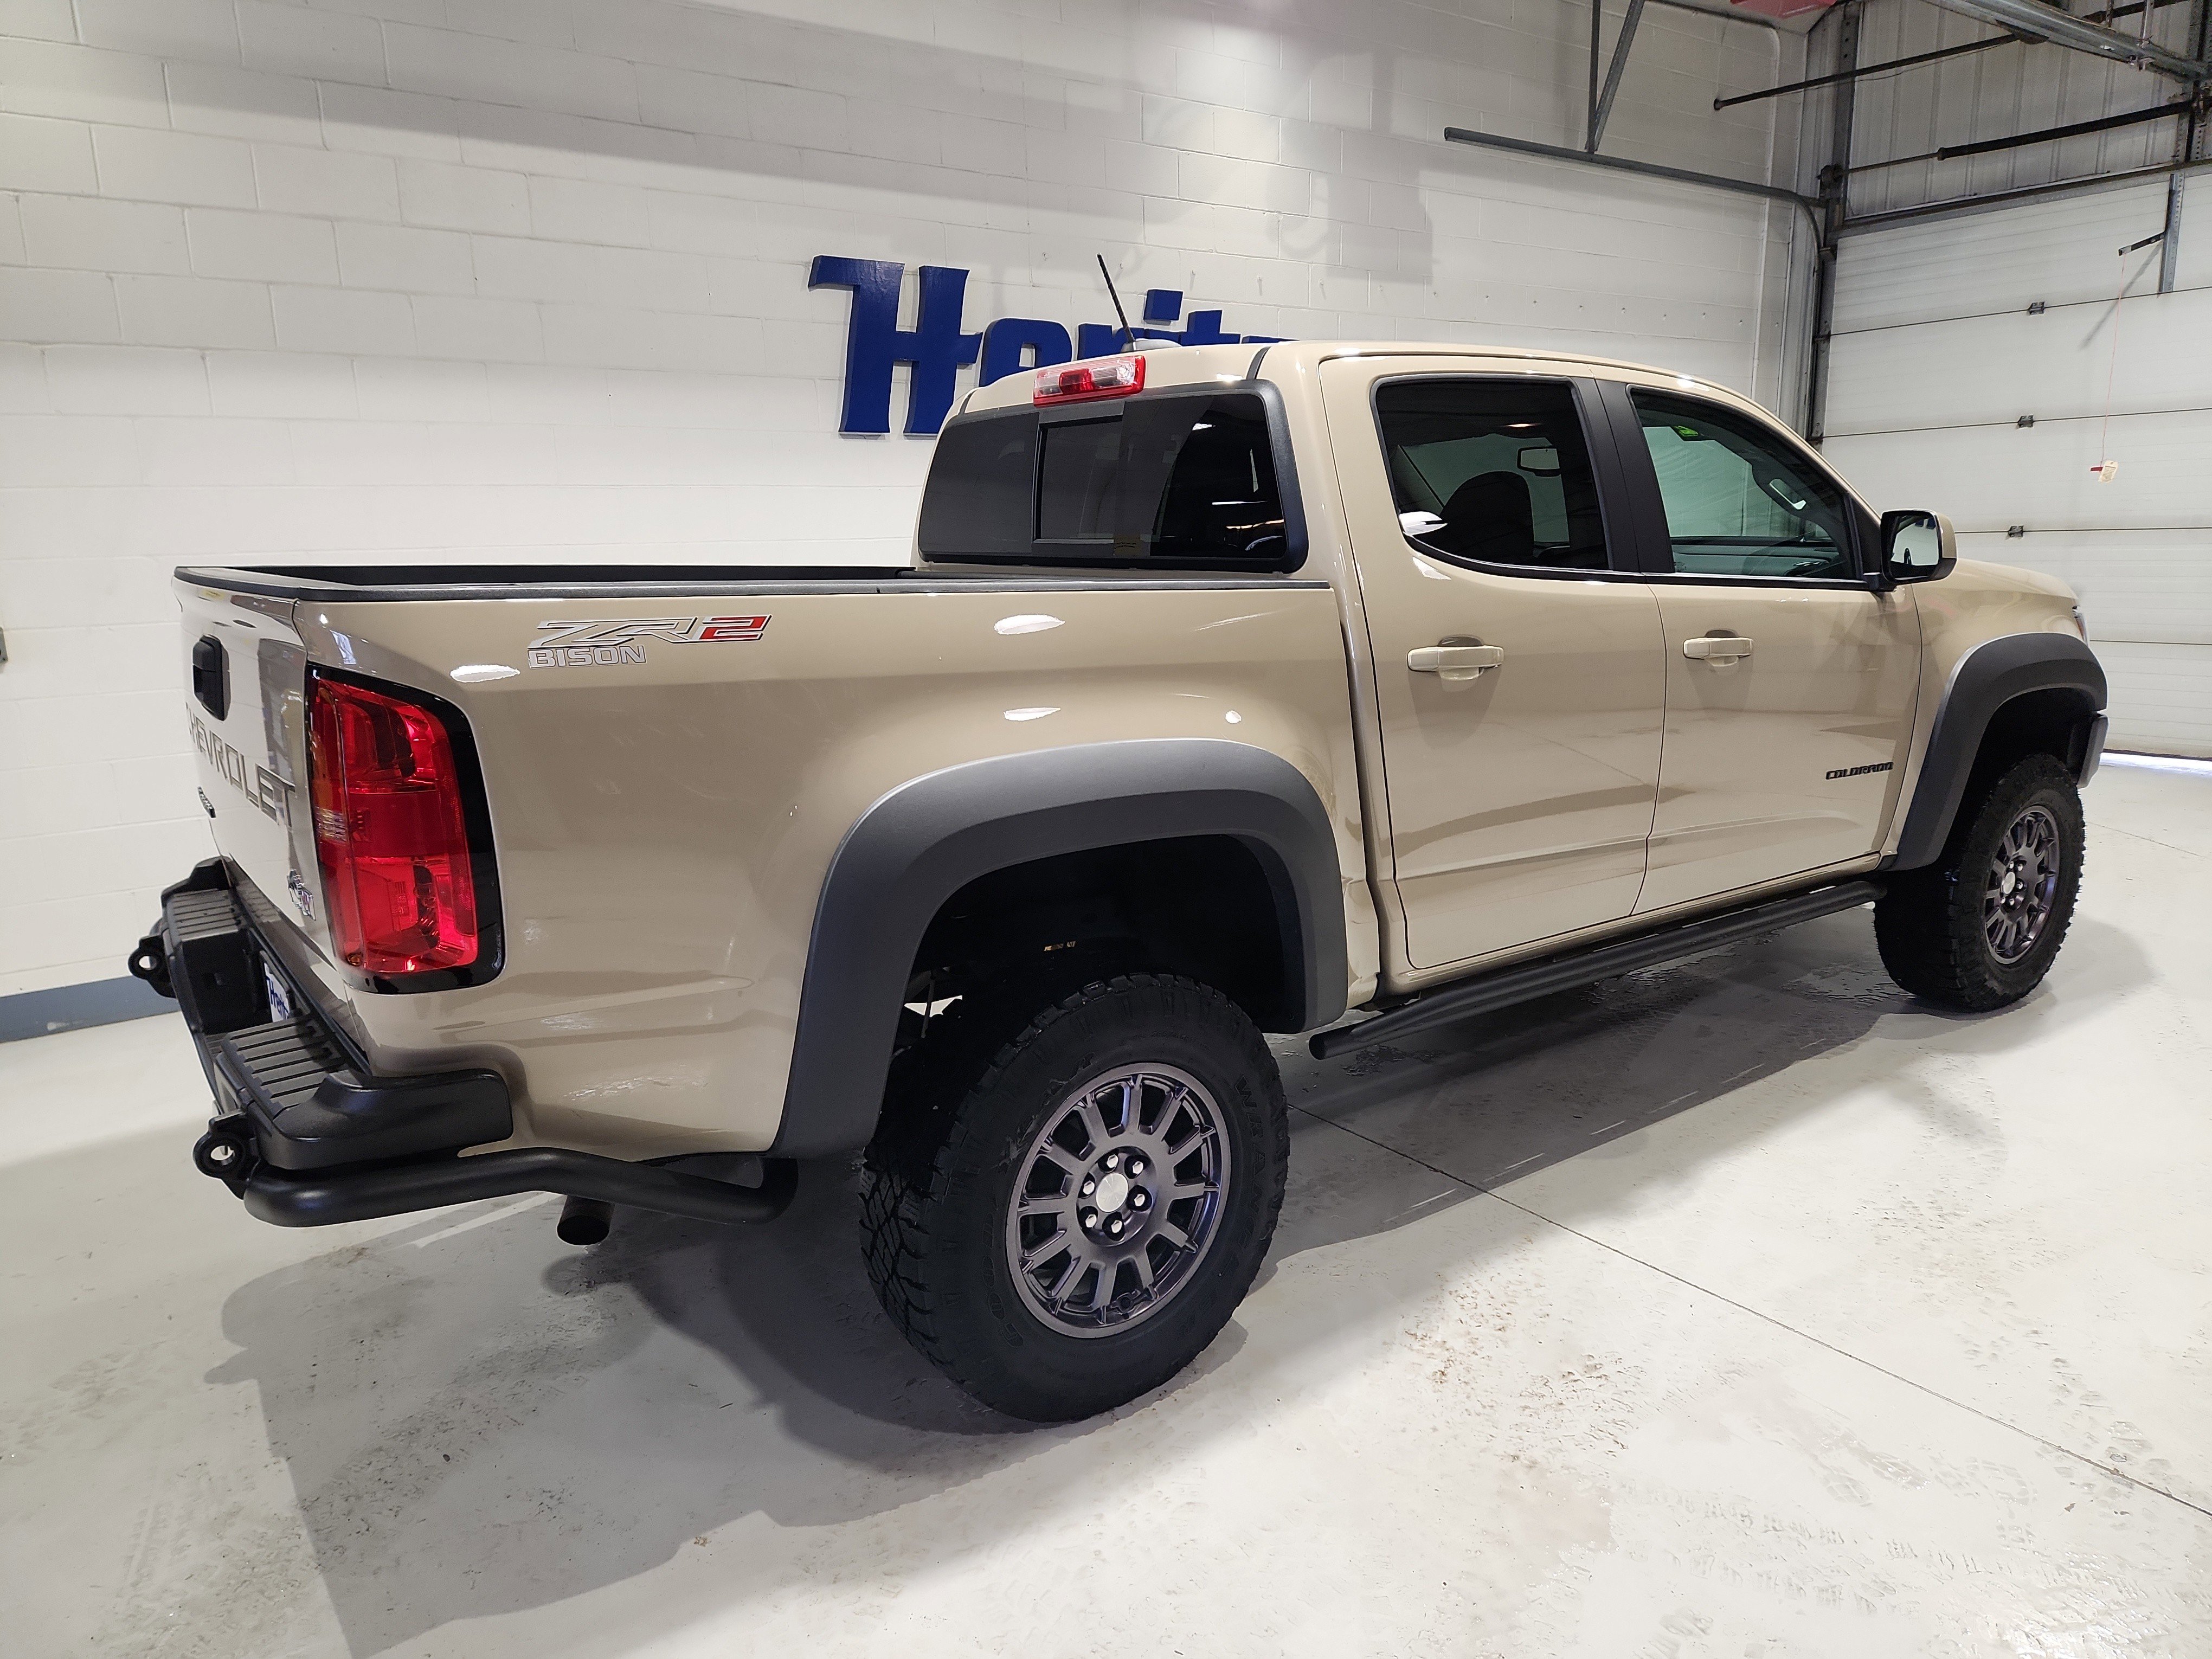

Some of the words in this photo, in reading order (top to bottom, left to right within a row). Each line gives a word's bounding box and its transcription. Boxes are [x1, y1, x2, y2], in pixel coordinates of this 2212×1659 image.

[528, 614, 772, 650] ZR2
[528, 646, 647, 668] BISON
[1825, 762, 1894, 780] COLORADO
[1177, 1073, 1266, 1342] WRANGLER
